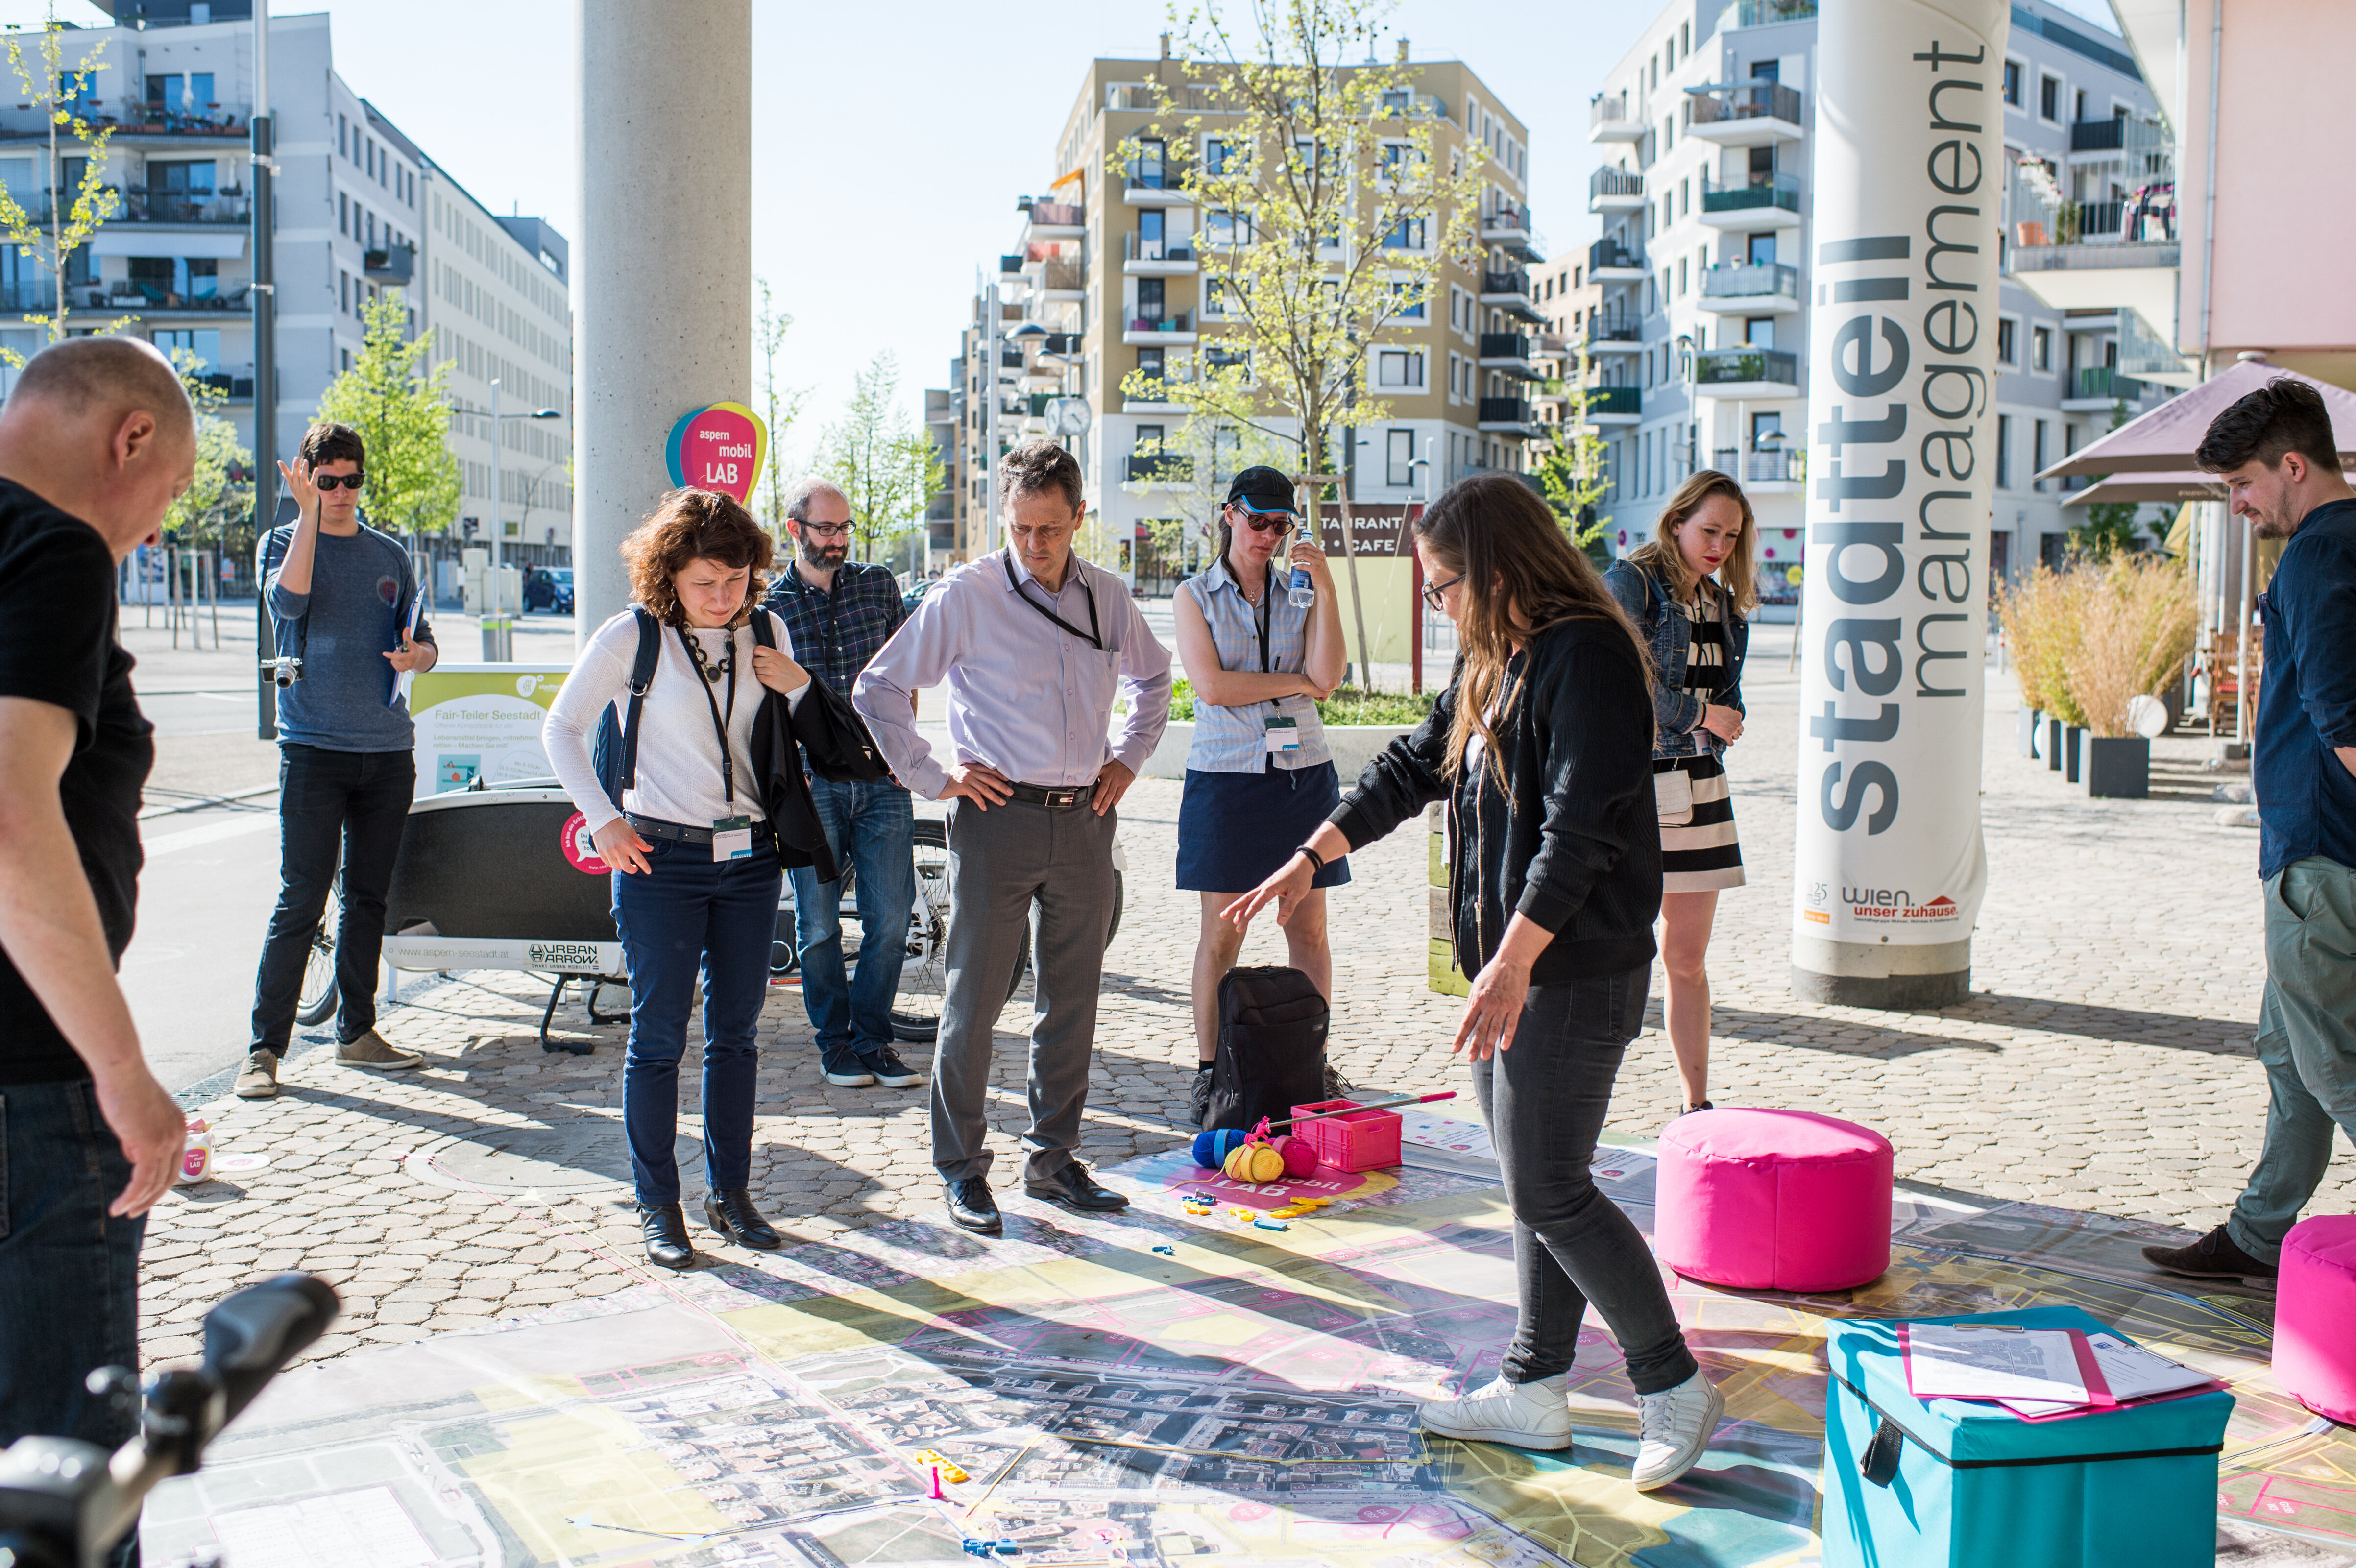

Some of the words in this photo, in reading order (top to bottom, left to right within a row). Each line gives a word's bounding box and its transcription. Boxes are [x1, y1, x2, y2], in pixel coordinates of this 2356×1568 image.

[1913, 41, 1986, 698] management
[700, 430, 729, 442] aspern
[719, 443, 752, 458] mobil
[706, 462, 738, 484] LAB
[1810, 236, 1910, 836] stadtteil
[1352, 539, 1395, 551] CAFE
[436, 710, 489, 720] Fair-Teiler
[492, 710, 541, 720] Seestadt
[1854, 906, 1897, 917] unser
[1902, 906, 1958, 917] zuhause.
[398, 947, 509, 959] www.aspern-seestadt.at
[545, 944, 597, 954] URBAN
[1211, 1180, 1292, 1197] LAB
